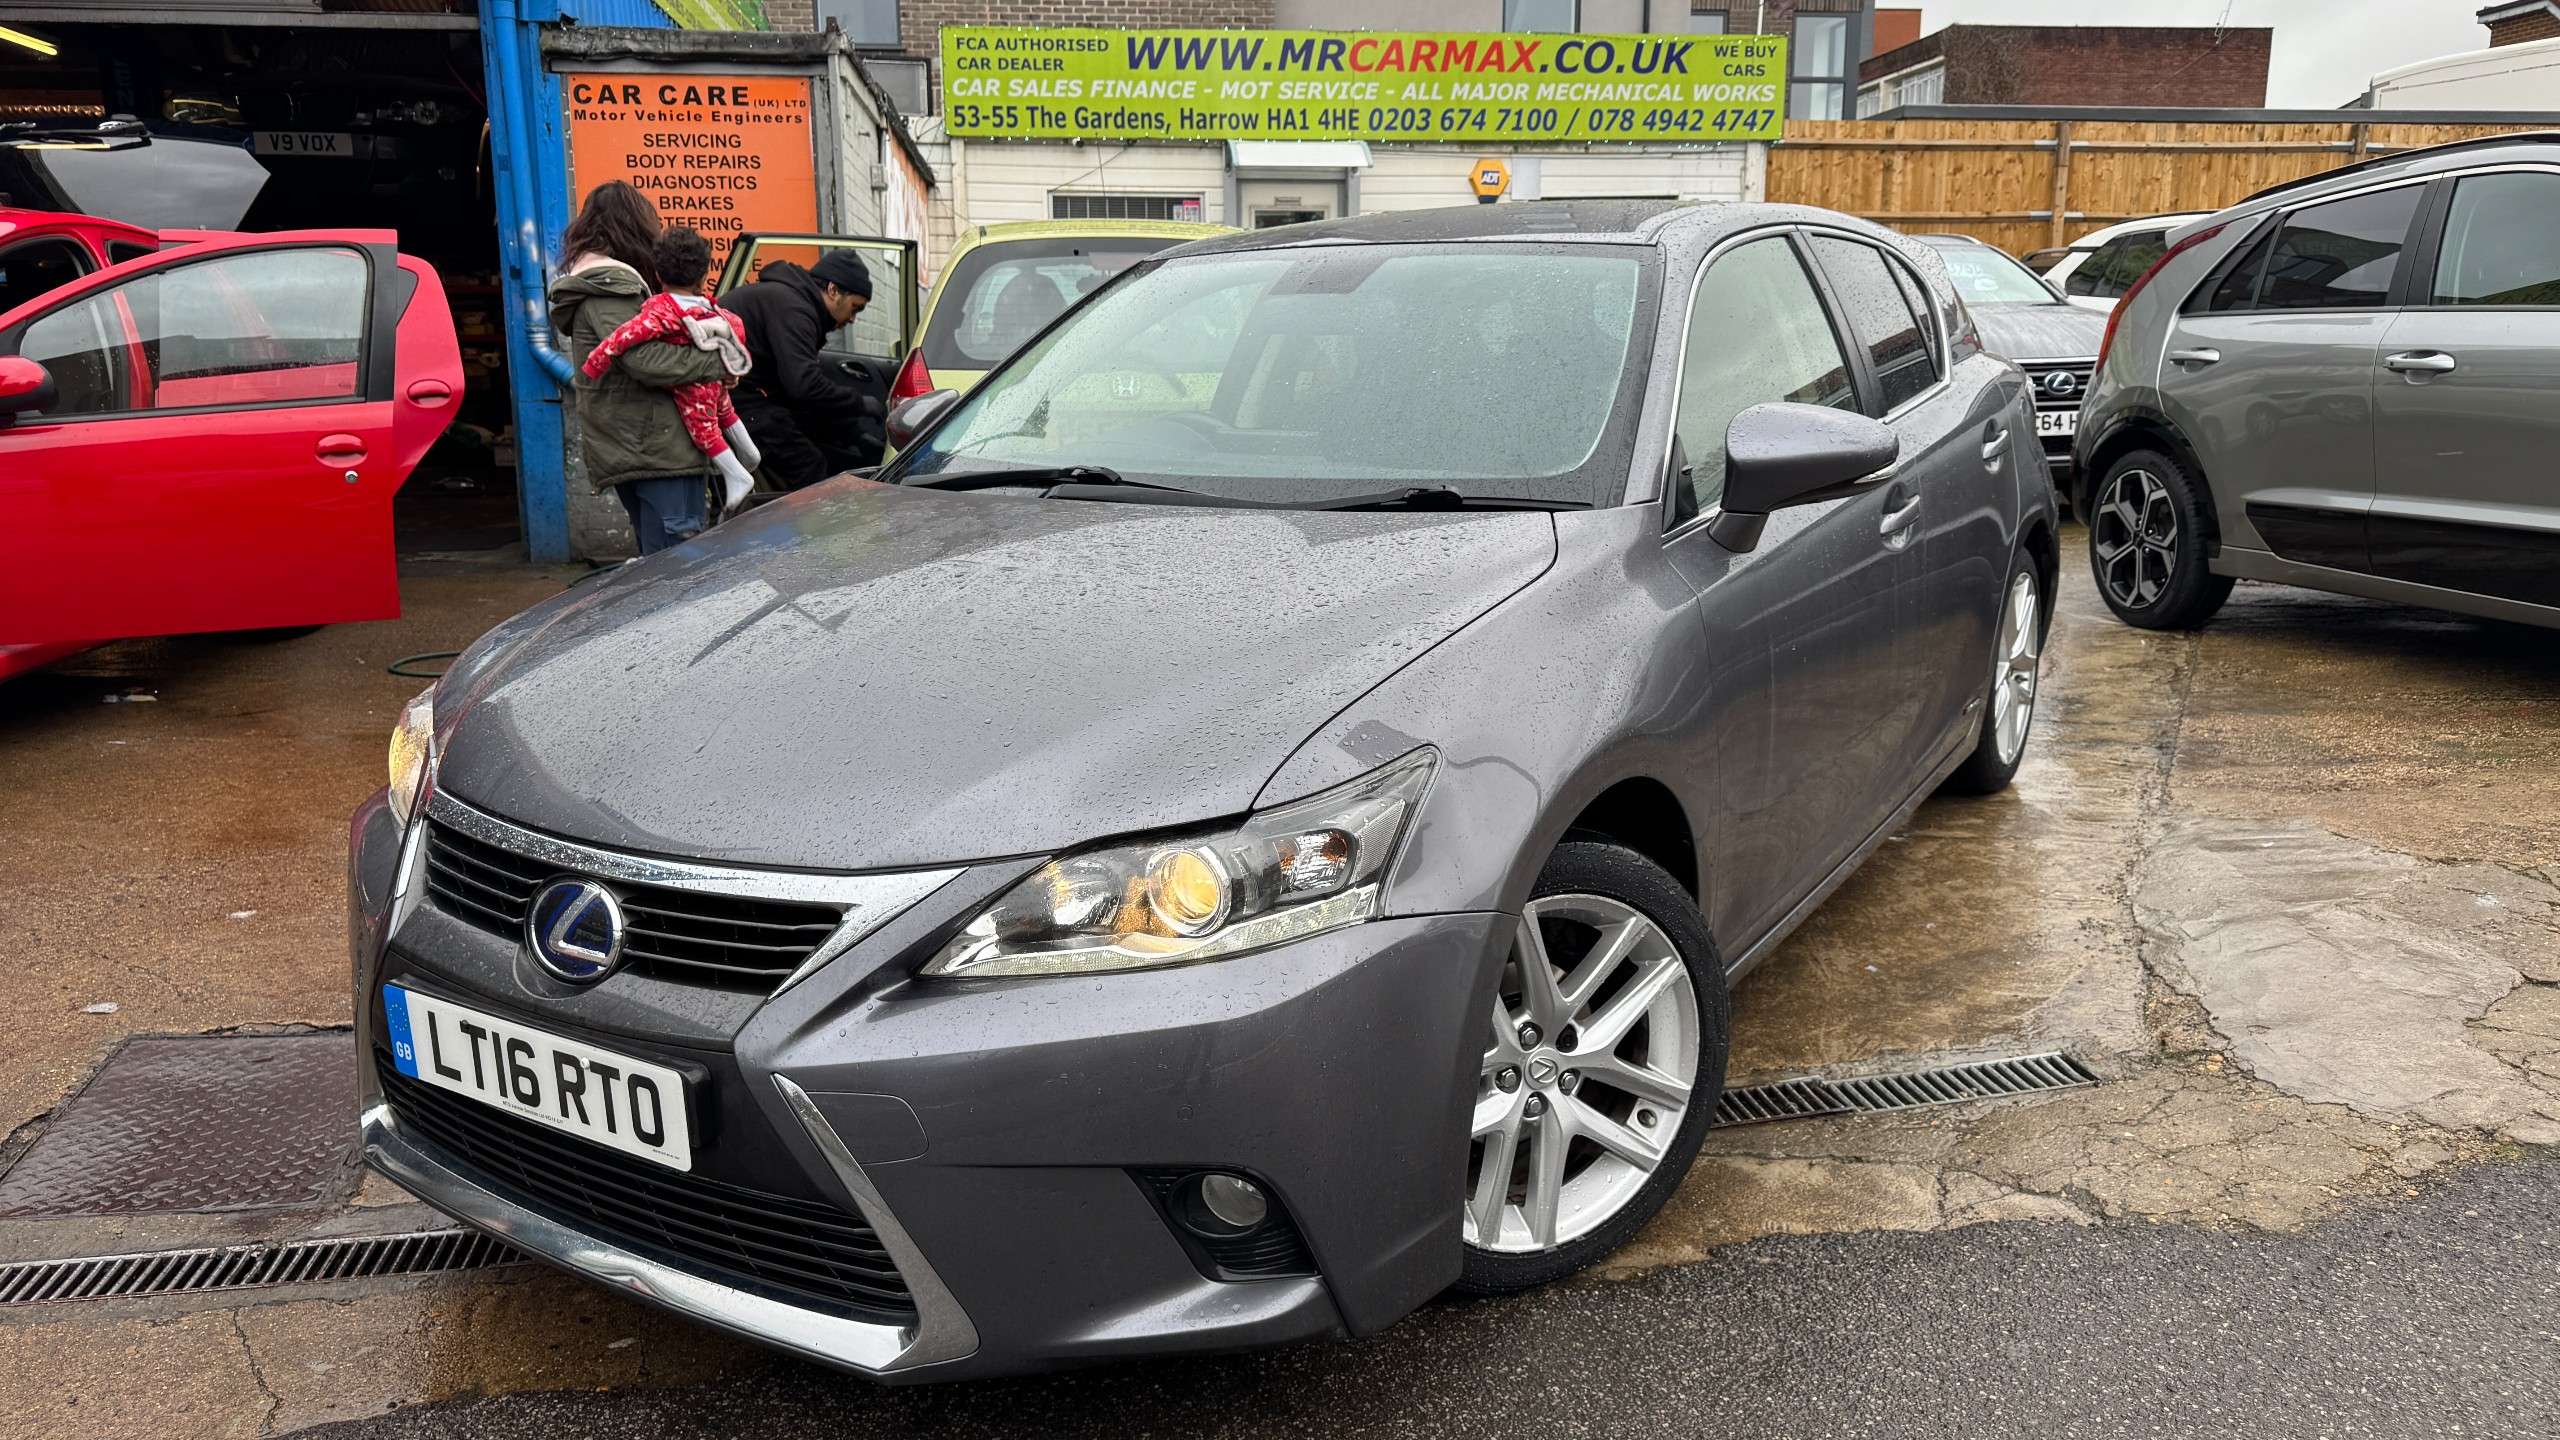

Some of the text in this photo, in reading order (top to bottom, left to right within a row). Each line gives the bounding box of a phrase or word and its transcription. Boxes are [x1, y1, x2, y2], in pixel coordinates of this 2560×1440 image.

[956, 37, 1109, 52] FCA AUTHORISED
[1714, 45, 1778, 58] WE BUY
[1127, 36, 1695, 75] WWW.MRCARMAX.CO.UK
[957, 56, 1065, 71] CAR DEALER
[1723, 64, 1766, 77] CARS
[573, 83, 750, 106] CAR CARE
[952, 77, 1001, 97] CAR
[1007, 78, 1083, 98] SALES
[1090, 79, 1197, 99] FINANCE
[1220, 80, 1274, 99] MOT
[1278, 81, 1380, 100] SERVICE
[1401, 82, 1443, 100] ALL
[1451, 82, 1530, 101] MAJOR
[1536, 83, 1684, 101] MECHANICAL
[1692, 84, 1777, 102] WORKS
[753, 98, 807, 109] (UK) LTD
[574, 109, 803, 125] Motor Vehicle Engineers
[953, 104, 1019, 129] 53-55
[1026, 105, 1067, 129] The
[1074, 105, 1172, 134] Gardens,
[1180, 107, 1259, 130] Harrow
[1267, 107, 1310, 131] HA1
[1318, 108, 1360, 131] 4HE
[1368, 107, 1432, 132] 0203
[1440, 107, 1487, 131] 674
[1495, 108, 1558, 132] 7100
[1588, 108, 1636, 132] 078
[1642, 108, 1705, 132] 4942
[1711, 108, 1776, 132] 4747
[269, 132, 337, 152] V9 VOX
[643, 133, 742, 148] SERVICING
[626, 154, 762, 169] BODY REPAIRS
[633, 175, 758, 190] DIAGNOSTICS
[1481, 170, 1500, 185] ADT
[659, 196, 735, 211] BRAKES
[395, 1039, 413, 1061] GB
[426, 1009, 665, 1148] LT16 RTO
